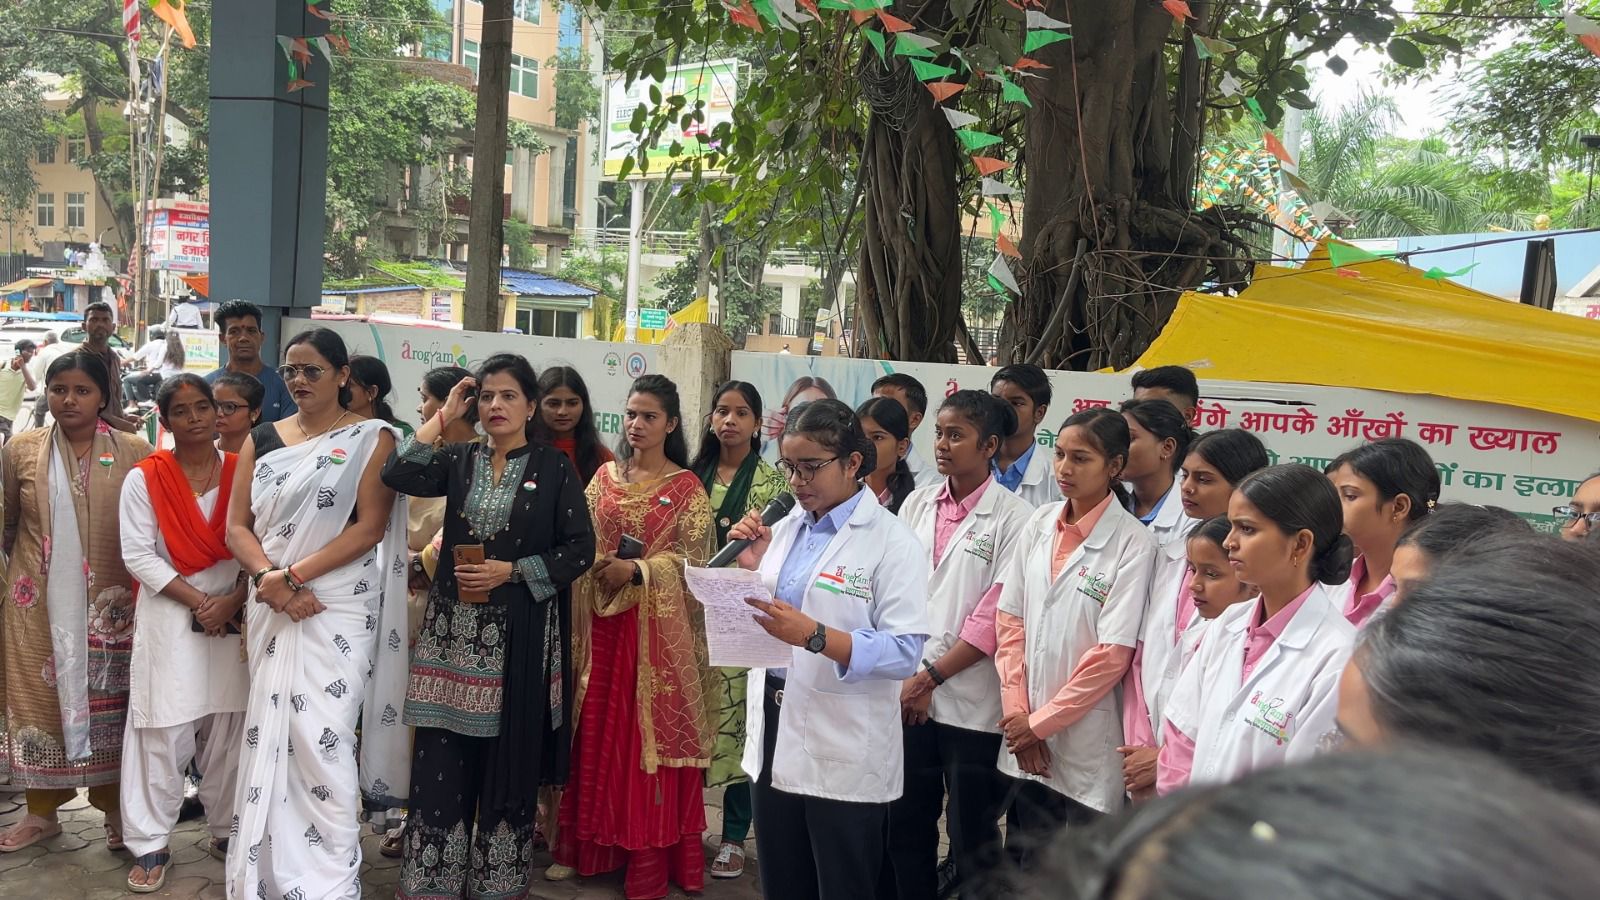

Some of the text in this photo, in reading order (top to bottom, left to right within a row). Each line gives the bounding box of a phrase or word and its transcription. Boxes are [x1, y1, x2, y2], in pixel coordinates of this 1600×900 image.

[176, 231, 200, 242] नगर
[181, 245, 209, 257] हजारी
[1239, 408, 1318, 435] आपके
[1327, 408, 1408, 441] आँखों
[1418, 422, 1458, 445] का
[1468, 426, 1561, 454] ख्याल
[1463, 470, 1506, 490] का
[1513, 475, 1580, 498] इला
